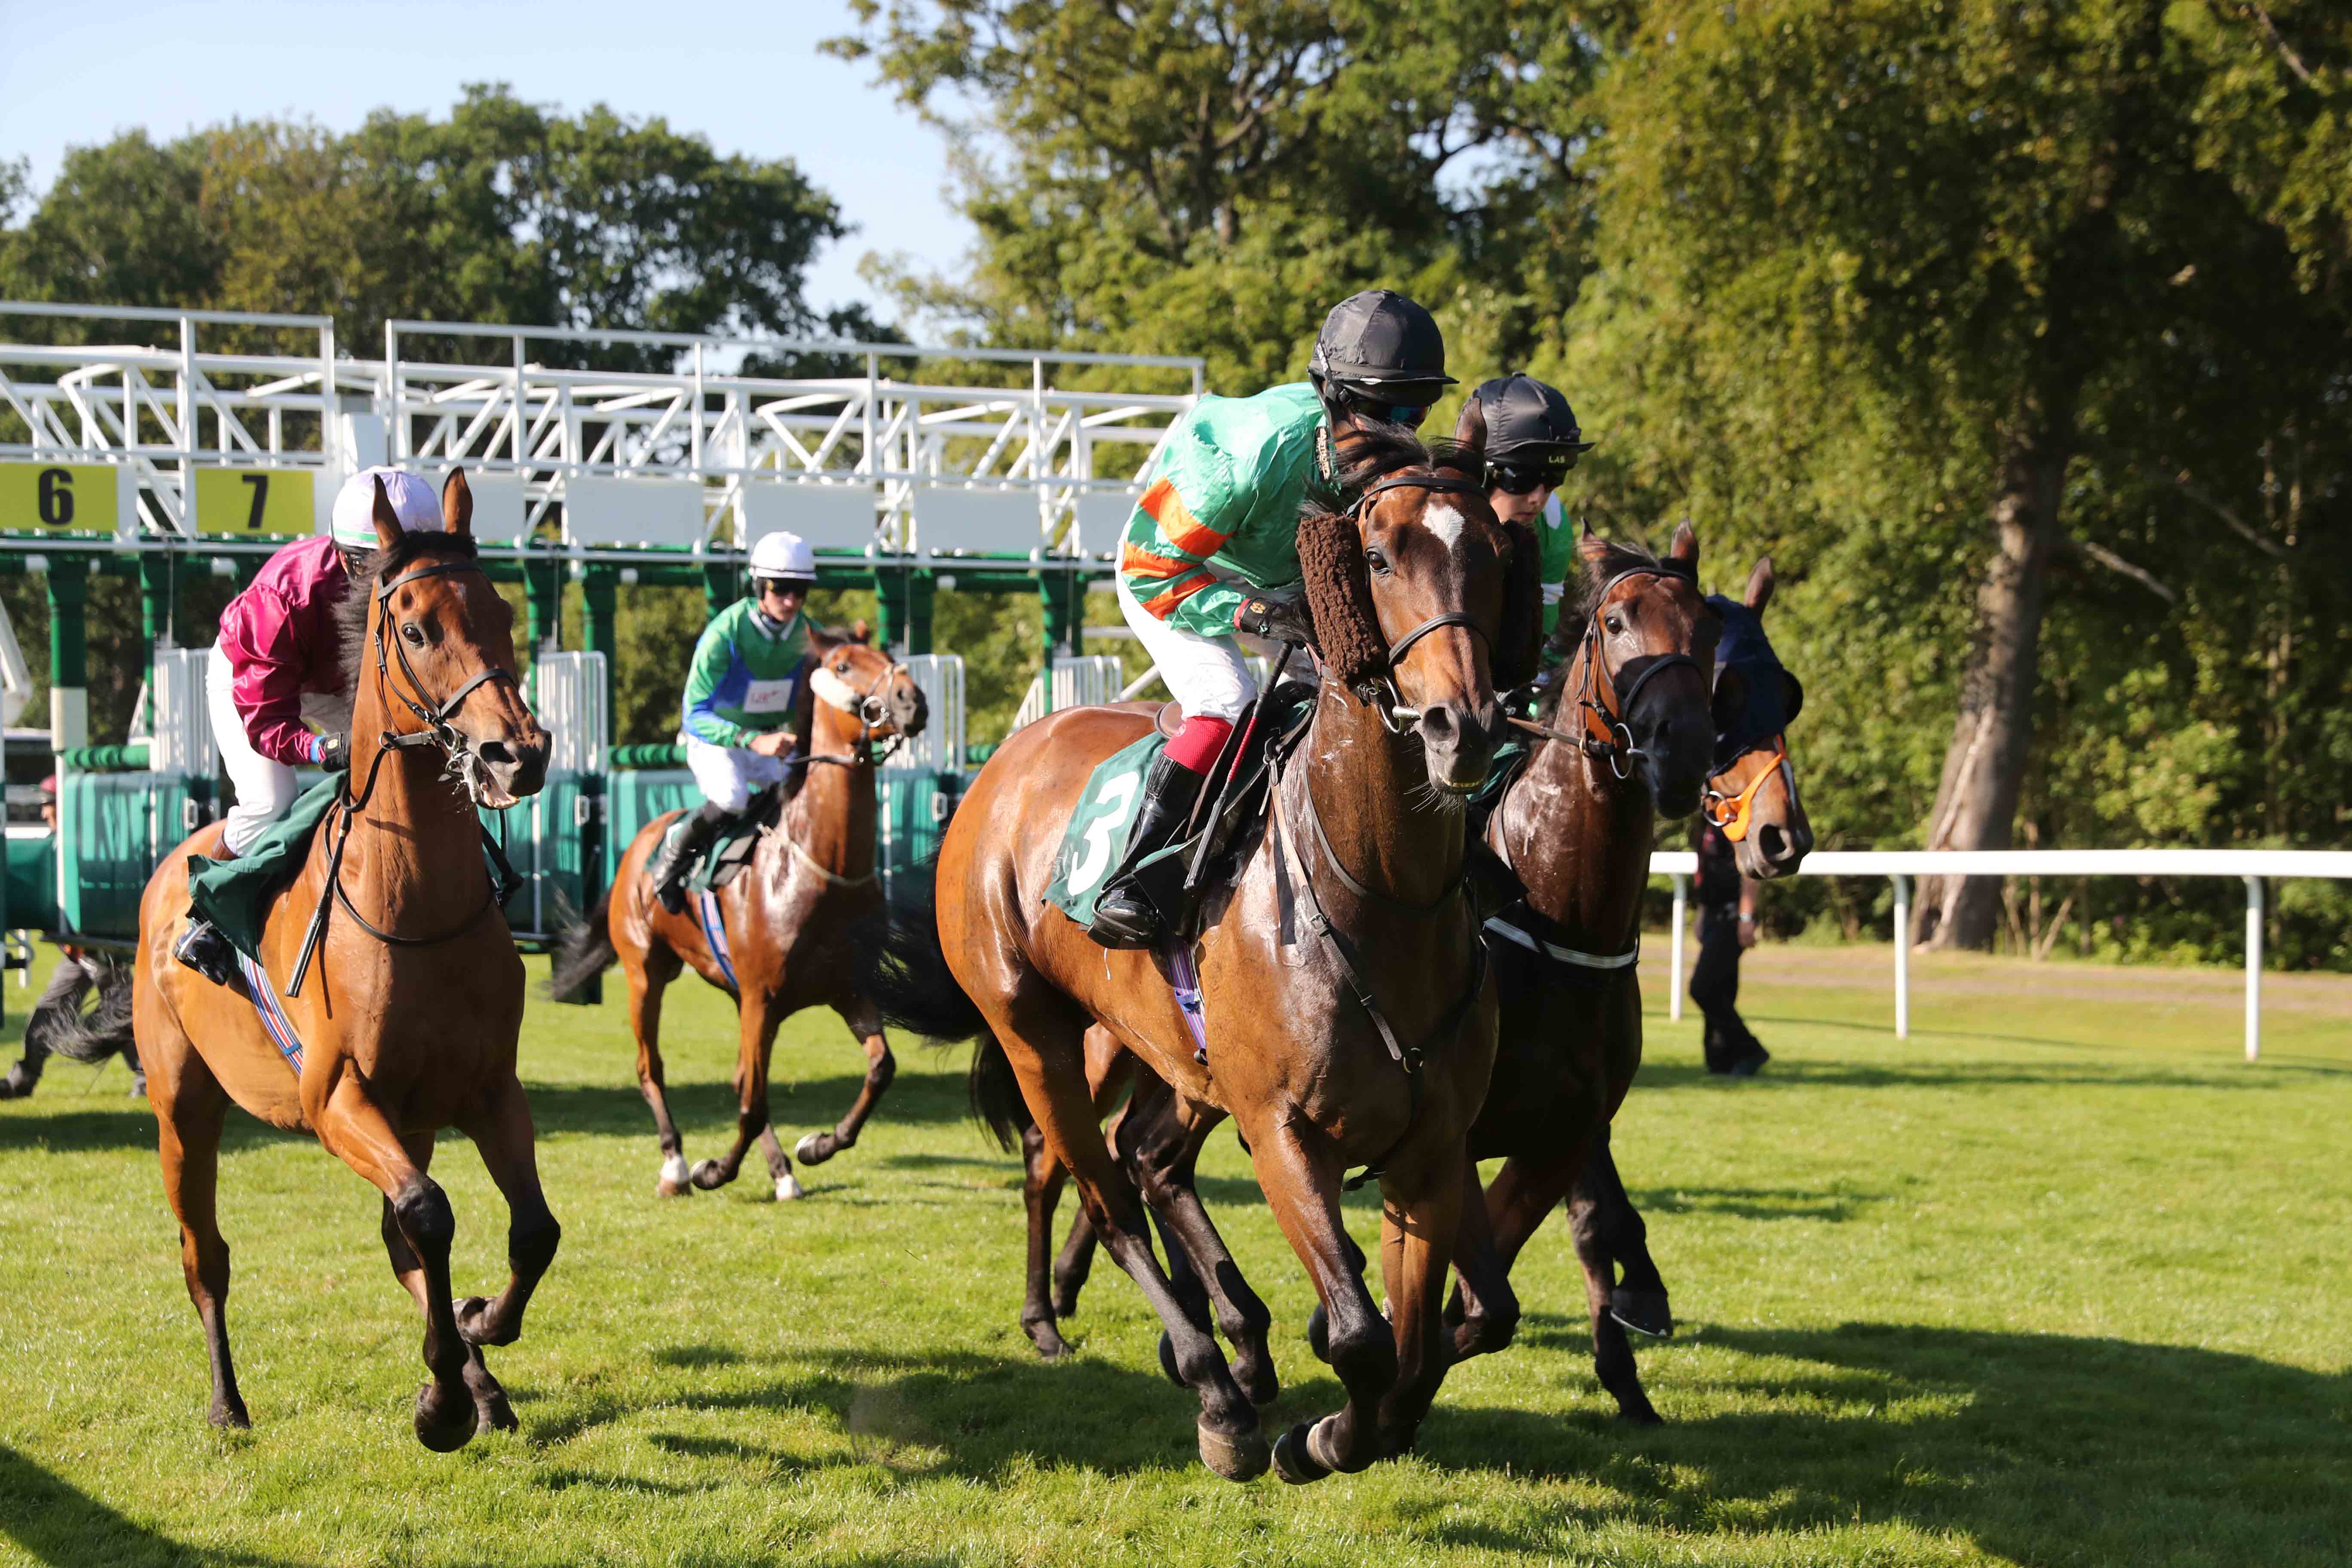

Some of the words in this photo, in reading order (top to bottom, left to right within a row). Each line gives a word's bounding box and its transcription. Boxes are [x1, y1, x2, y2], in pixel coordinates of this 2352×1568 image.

[38, 468, 74, 525] 6
[242, 475, 269, 528] 7
[1068, 772, 1139, 897] 3
